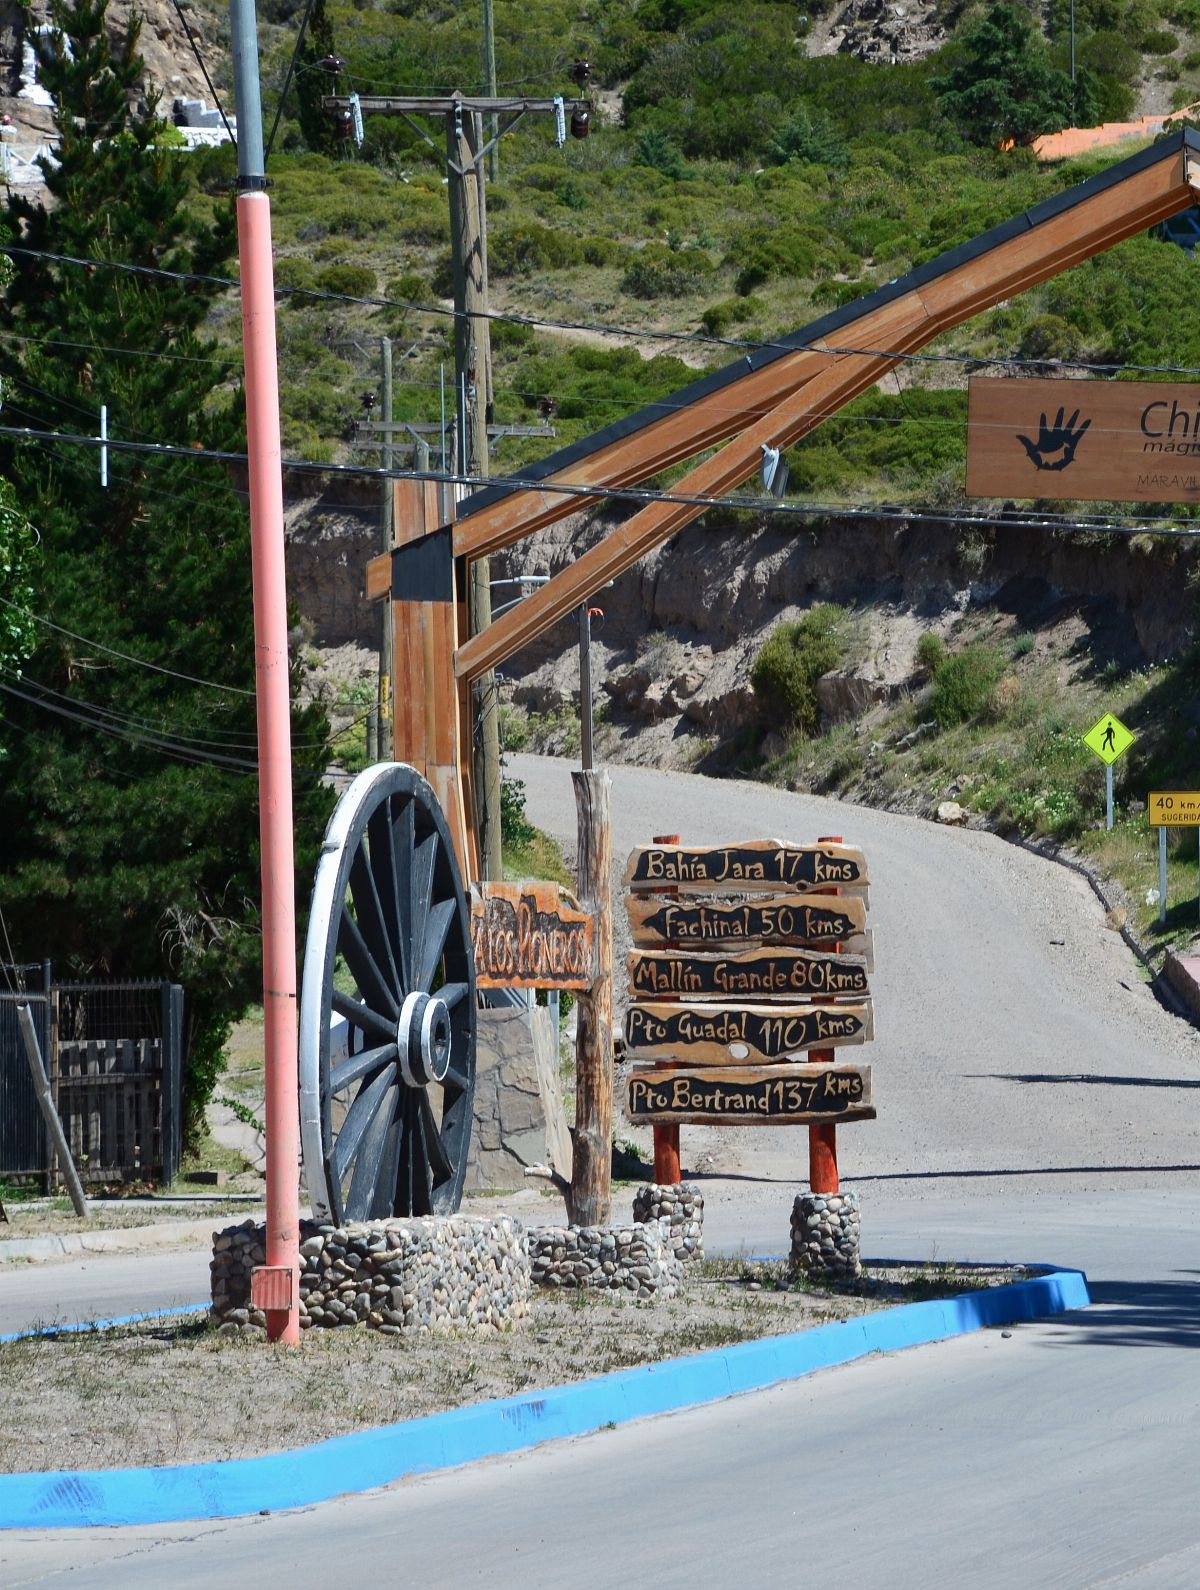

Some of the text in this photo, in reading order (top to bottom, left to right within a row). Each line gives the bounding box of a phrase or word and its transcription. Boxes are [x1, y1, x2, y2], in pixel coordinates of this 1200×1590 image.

[1156, 797, 1174, 809] 40
[648, 850, 852, 882] Bahía Jara 17 kms
[665, 907, 844, 939] Fachinal 50 kms
[488, 928, 514, 974] LOS
[636, 962, 702, 992] Mallín
[713, 962, 787, 992] Grande
[629, 1010, 855, 1056] Pto Guadal 110 kms
[632, 1070, 863, 1113] Pto Bertrand 137 kms
